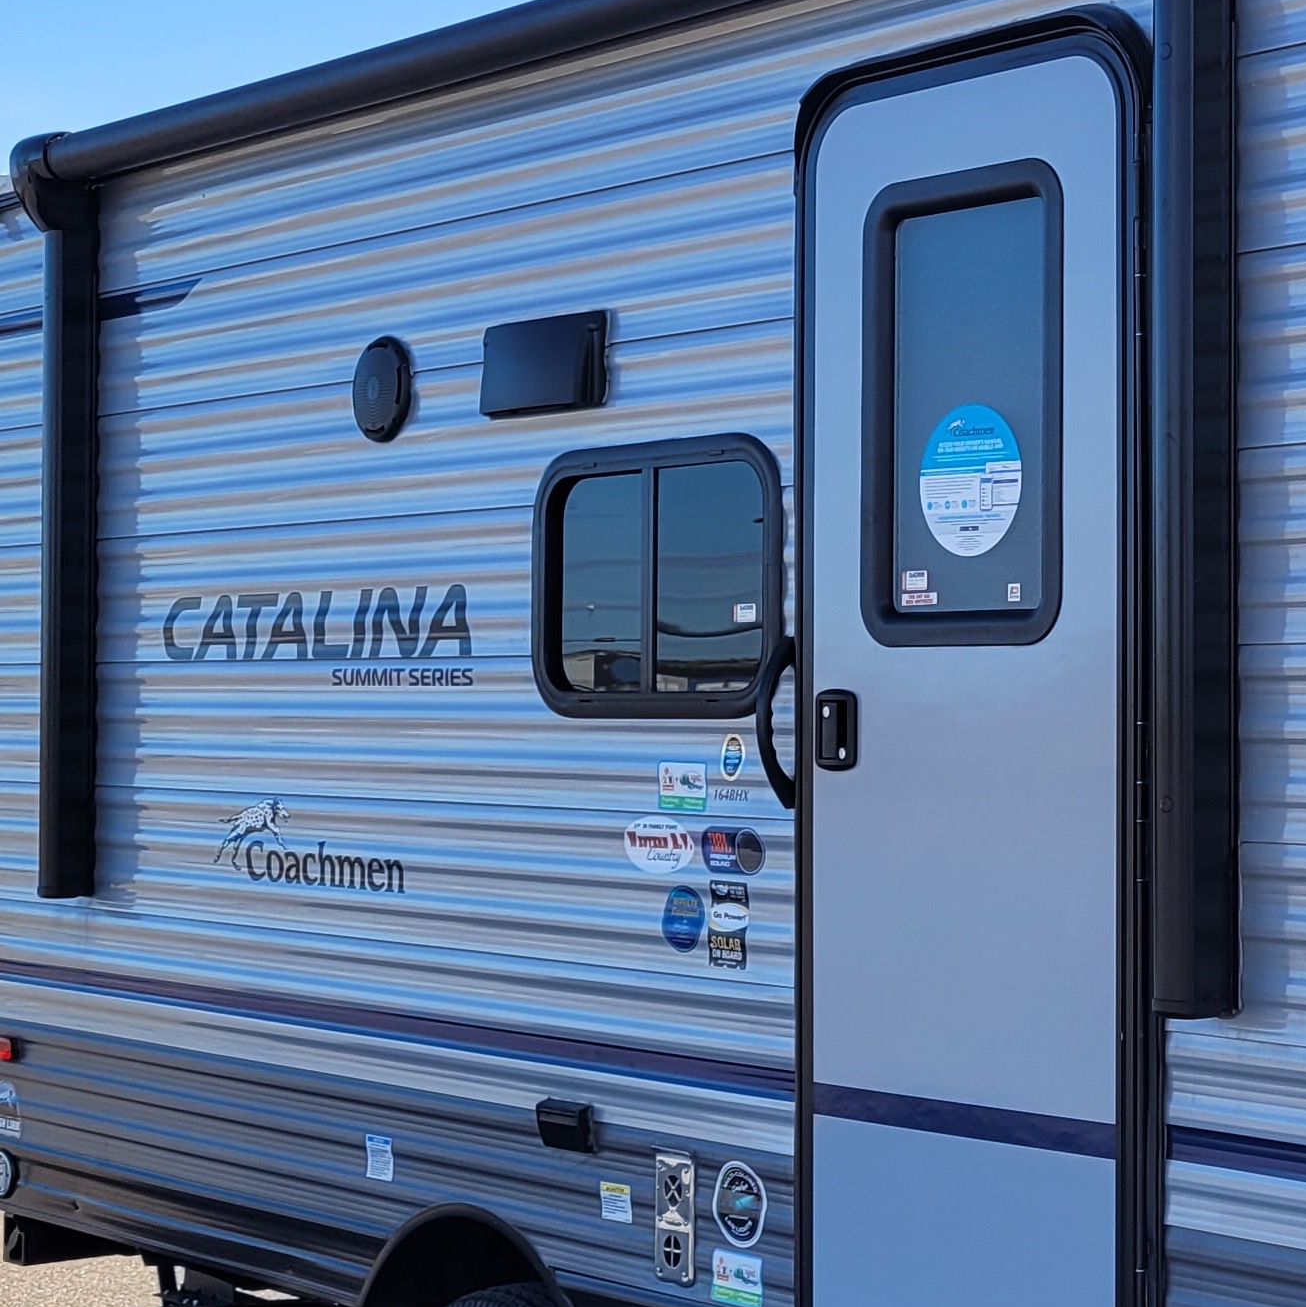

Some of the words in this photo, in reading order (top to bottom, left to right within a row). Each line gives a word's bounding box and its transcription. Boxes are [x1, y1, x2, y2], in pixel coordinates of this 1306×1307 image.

[163, 584, 472, 660] CATALINA
[332, 668, 405, 686] SUMMIT
[408, 668, 473, 687] SERIES
[714, 789, 749, 801] 164BHX
[245, 840, 405, 894] Coachmen
[713, 911, 722, 919] Go
[710, 935, 742, 951] SOLAR
[721, 951, 742, 961] BOARD
